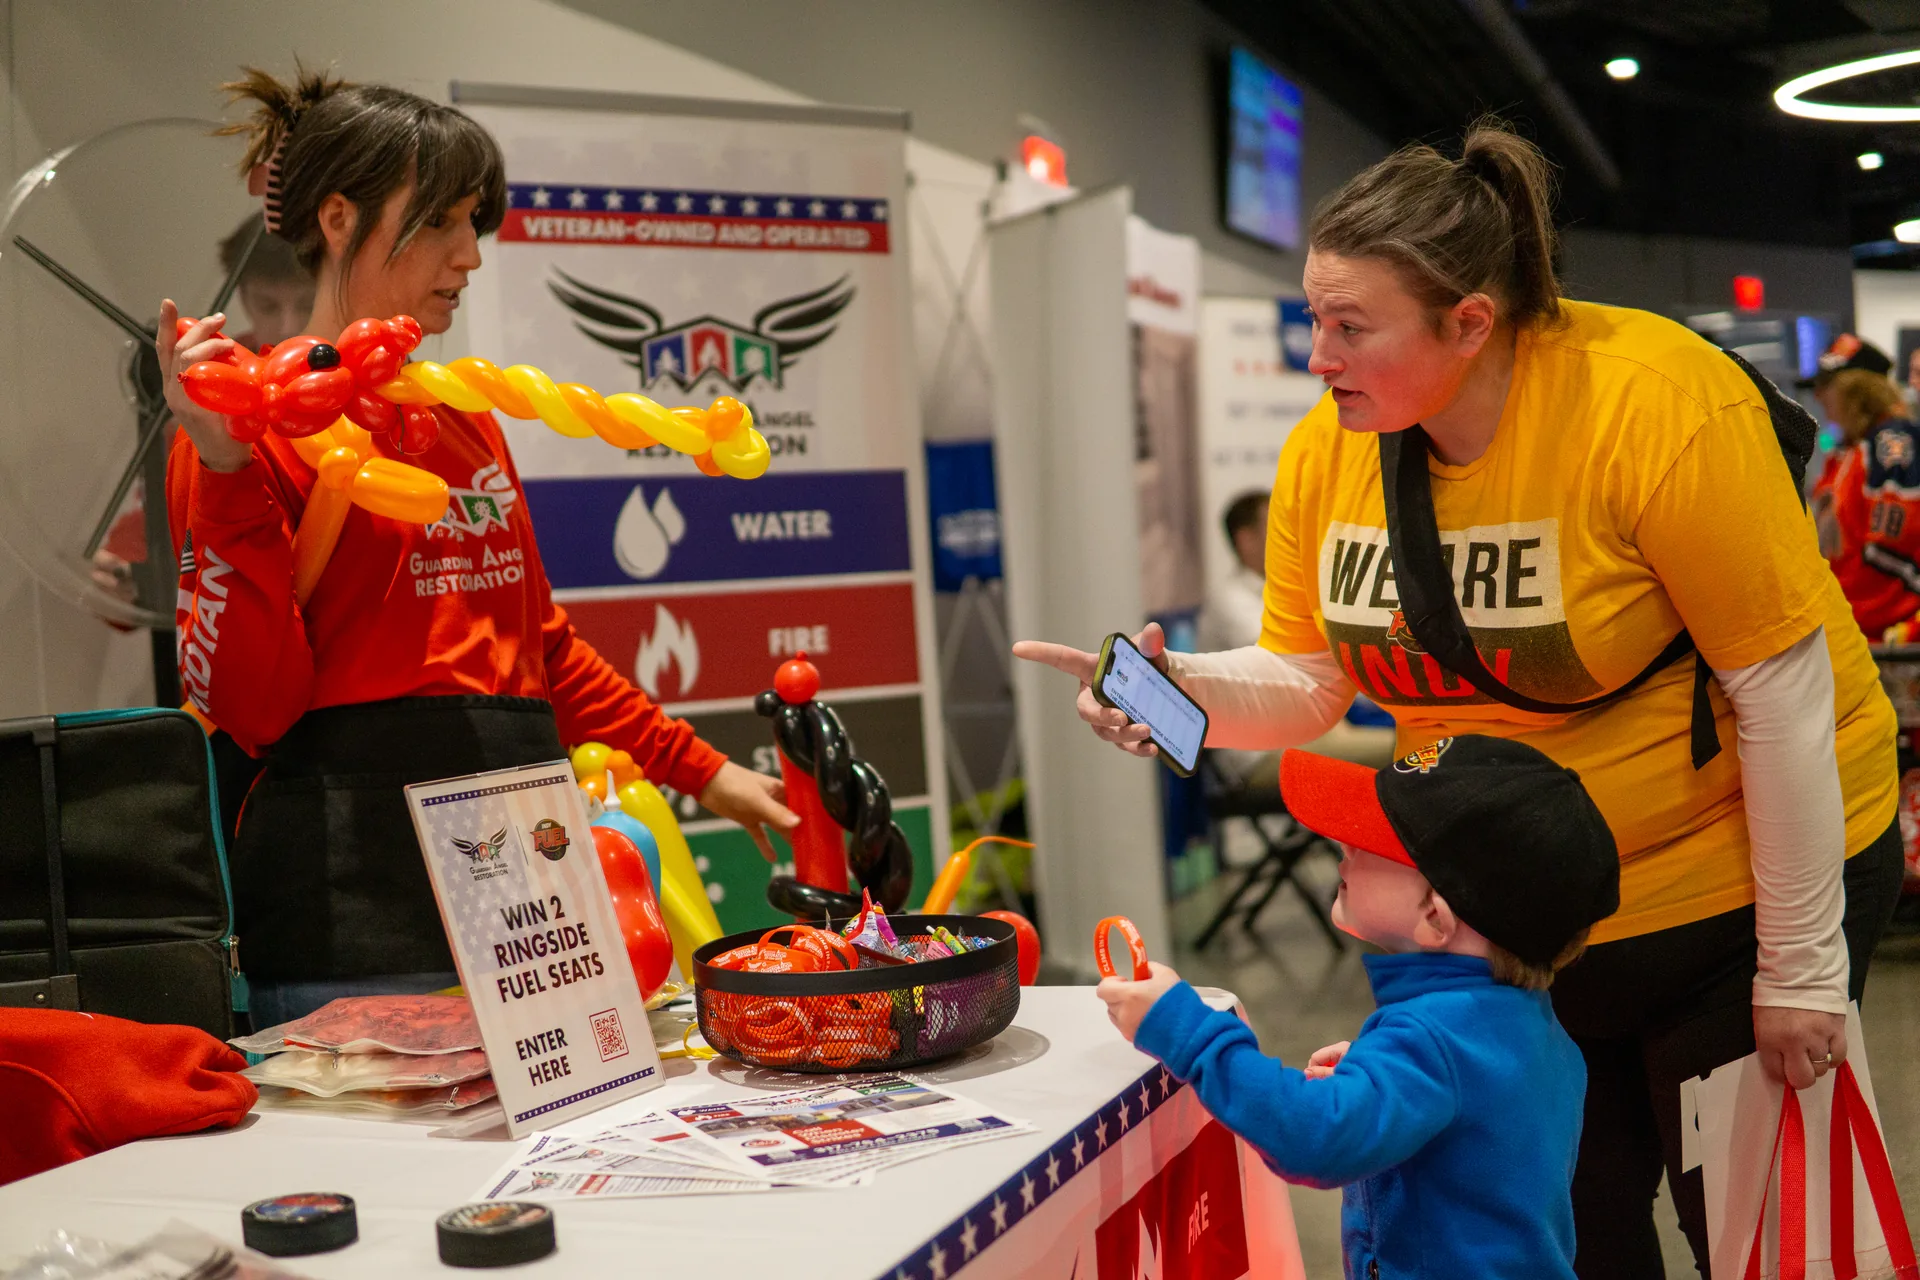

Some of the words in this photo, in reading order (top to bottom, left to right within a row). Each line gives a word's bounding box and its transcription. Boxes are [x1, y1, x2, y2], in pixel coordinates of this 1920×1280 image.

[523, 215, 716, 243] VETERAN-OWNED
[717, 223, 763, 245] AND
[765, 224, 870, 248] OPERATED
[731, 511, 831, 541] WATER
[1441, 537, 1543, 609] RE
[768, 626, 829, 656] FIRE
[533, 827, 570, 851] FUEL
[474, 869, 508, 881] RESTORATION
[500, 899, 548, 931] WIN
[551, 895, 566, 920] 2
[494, 922, 590, 968] RINGSIDE
[496, 969, 546, 1003] FUEL
[547, 951, 605, 989] SEATS
[516, 1027, 568, 1061] ENTER
[528, 1055, 572, 1087] HERE
[1188, 1191, 1209, 1254] FIRE
